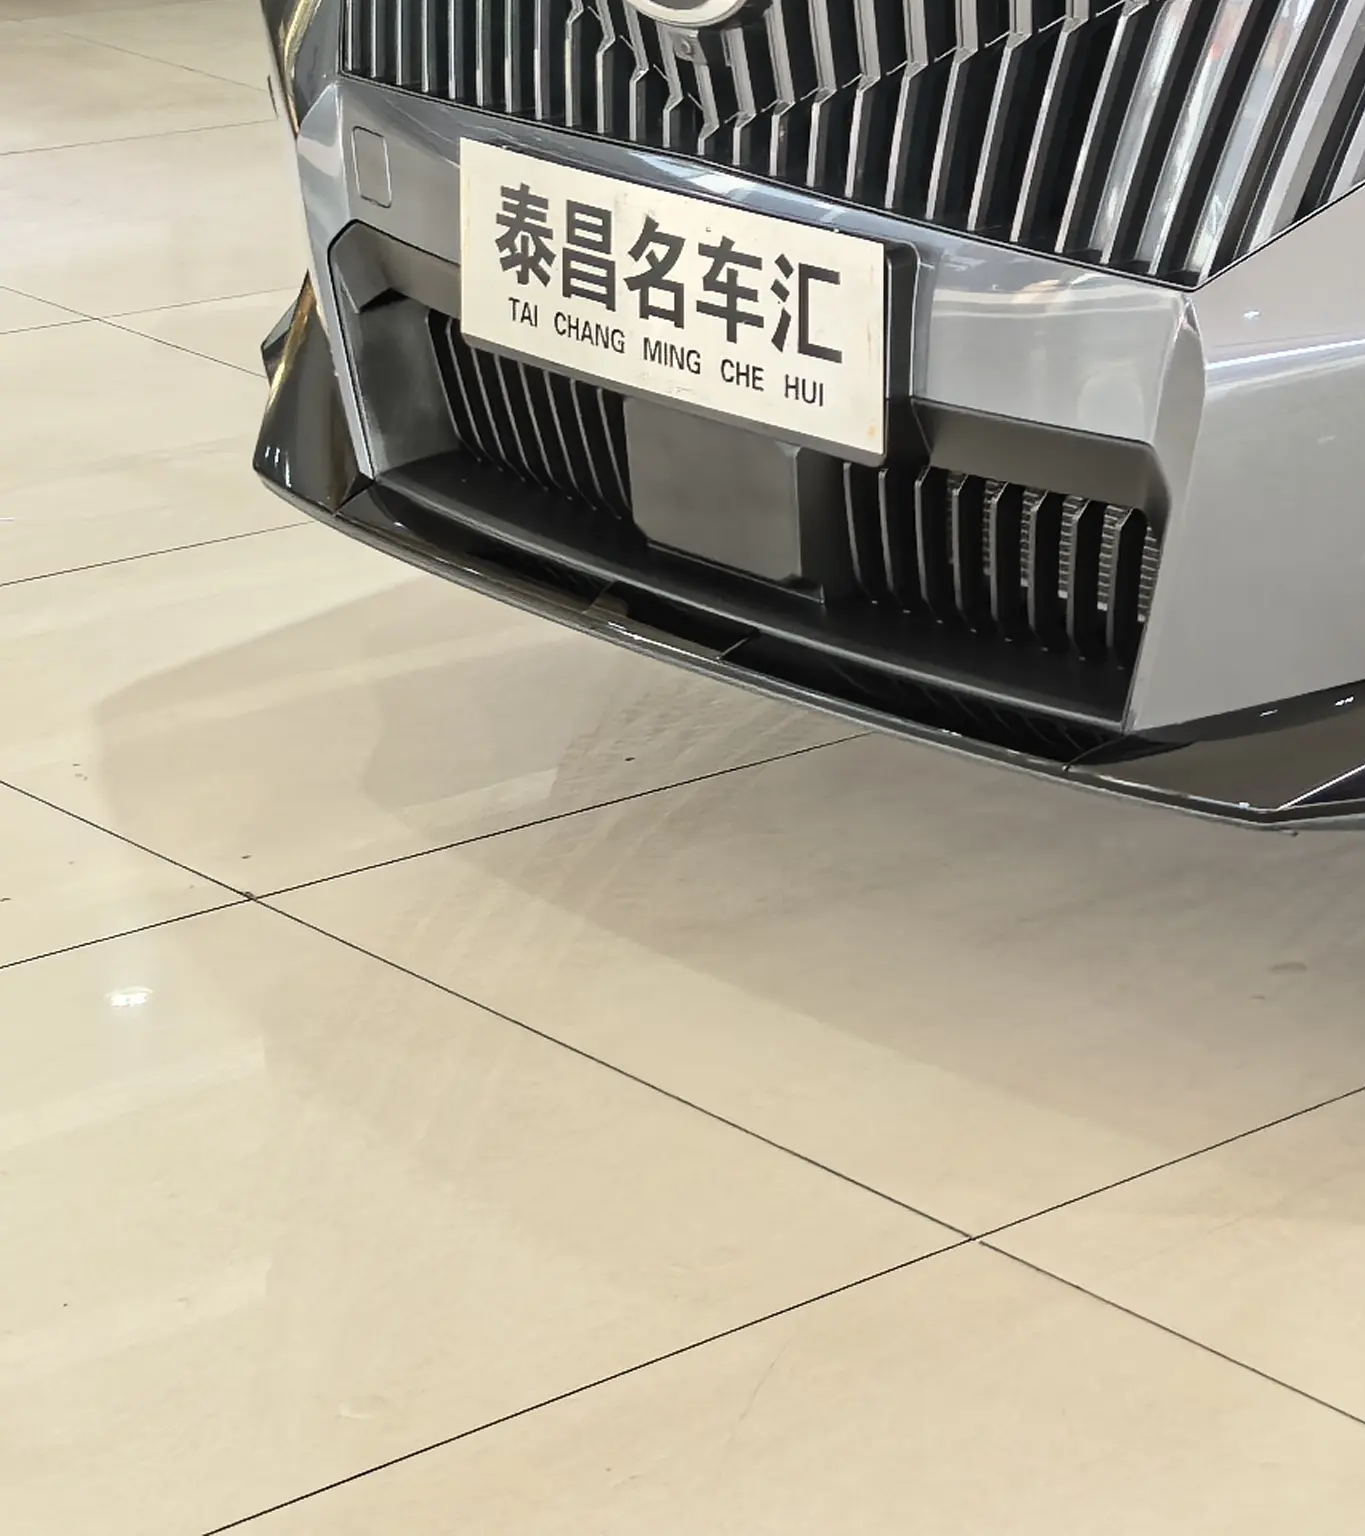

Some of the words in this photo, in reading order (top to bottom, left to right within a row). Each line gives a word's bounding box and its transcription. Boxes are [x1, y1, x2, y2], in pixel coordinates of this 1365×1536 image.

[495, 182, 843, 364] 泰昌名车汇
[509, 296, 539, 328] TAI
[554, 312, 626, 354] CHANG
[643, 336, 702, 375] MING
[720, 358, 764, 392] CHE
[784, 373, 825, 408] HUI
